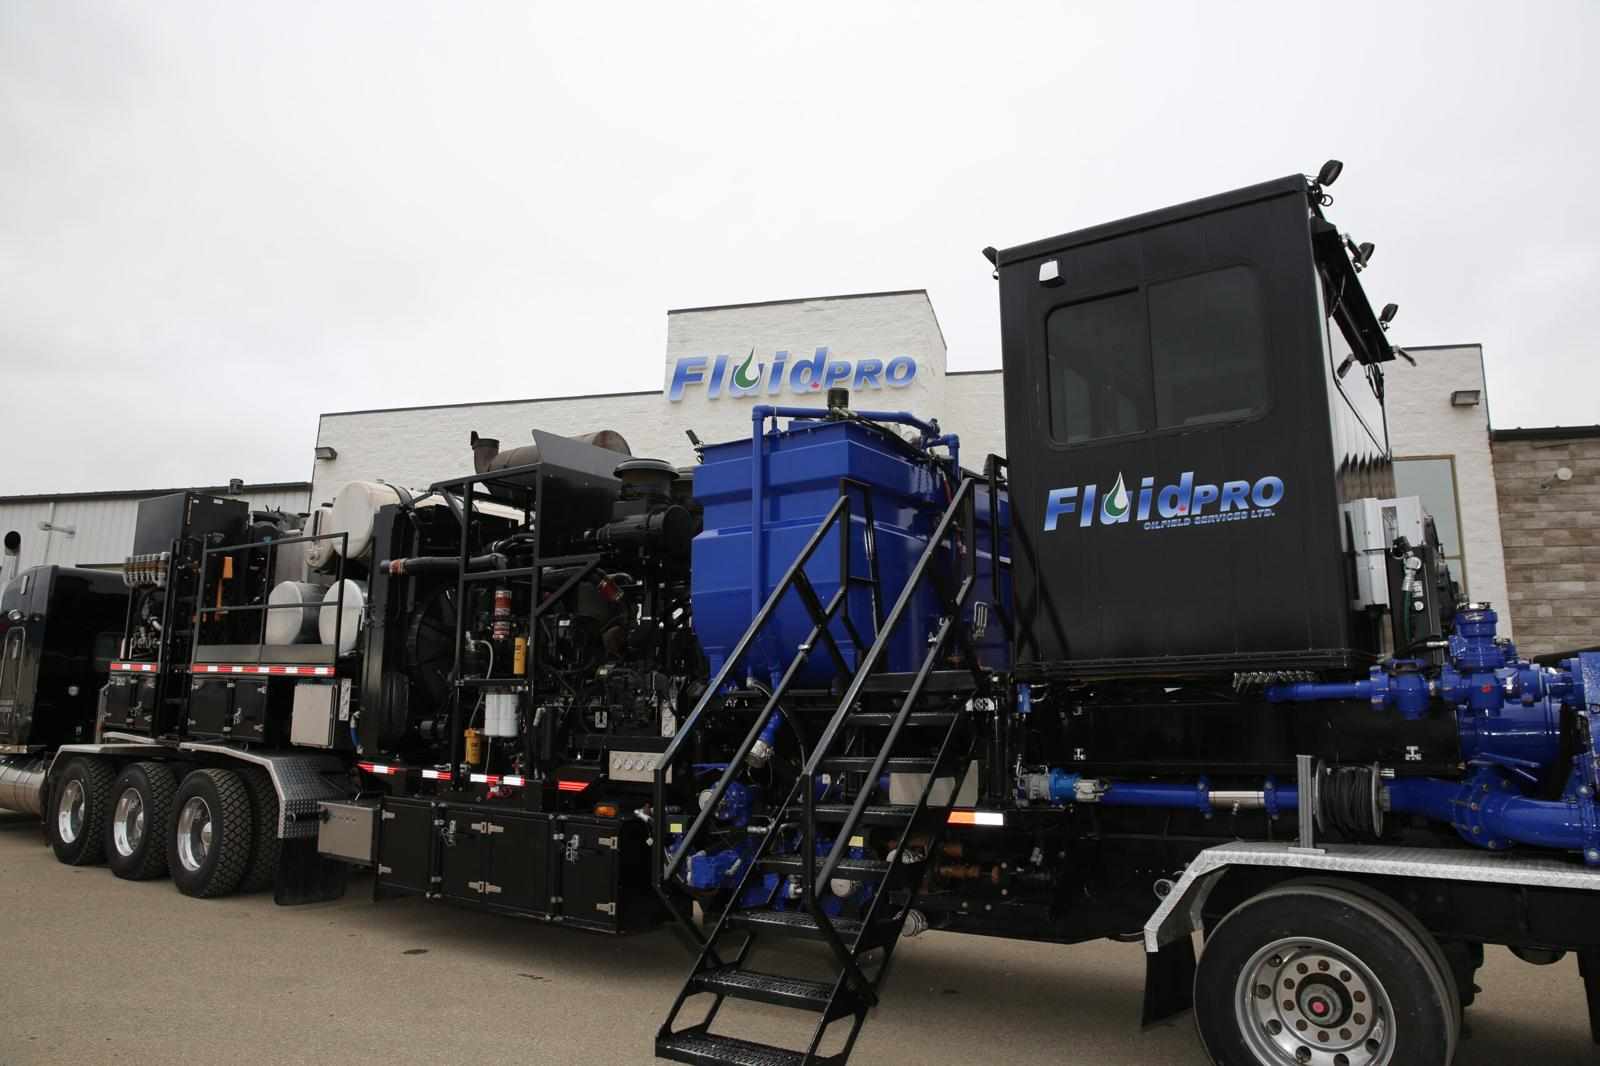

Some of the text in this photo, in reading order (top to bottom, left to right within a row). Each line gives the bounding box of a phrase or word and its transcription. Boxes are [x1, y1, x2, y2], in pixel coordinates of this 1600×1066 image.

[1144, 508, 1275, 530] OILFIELD SERVICES LTD.
